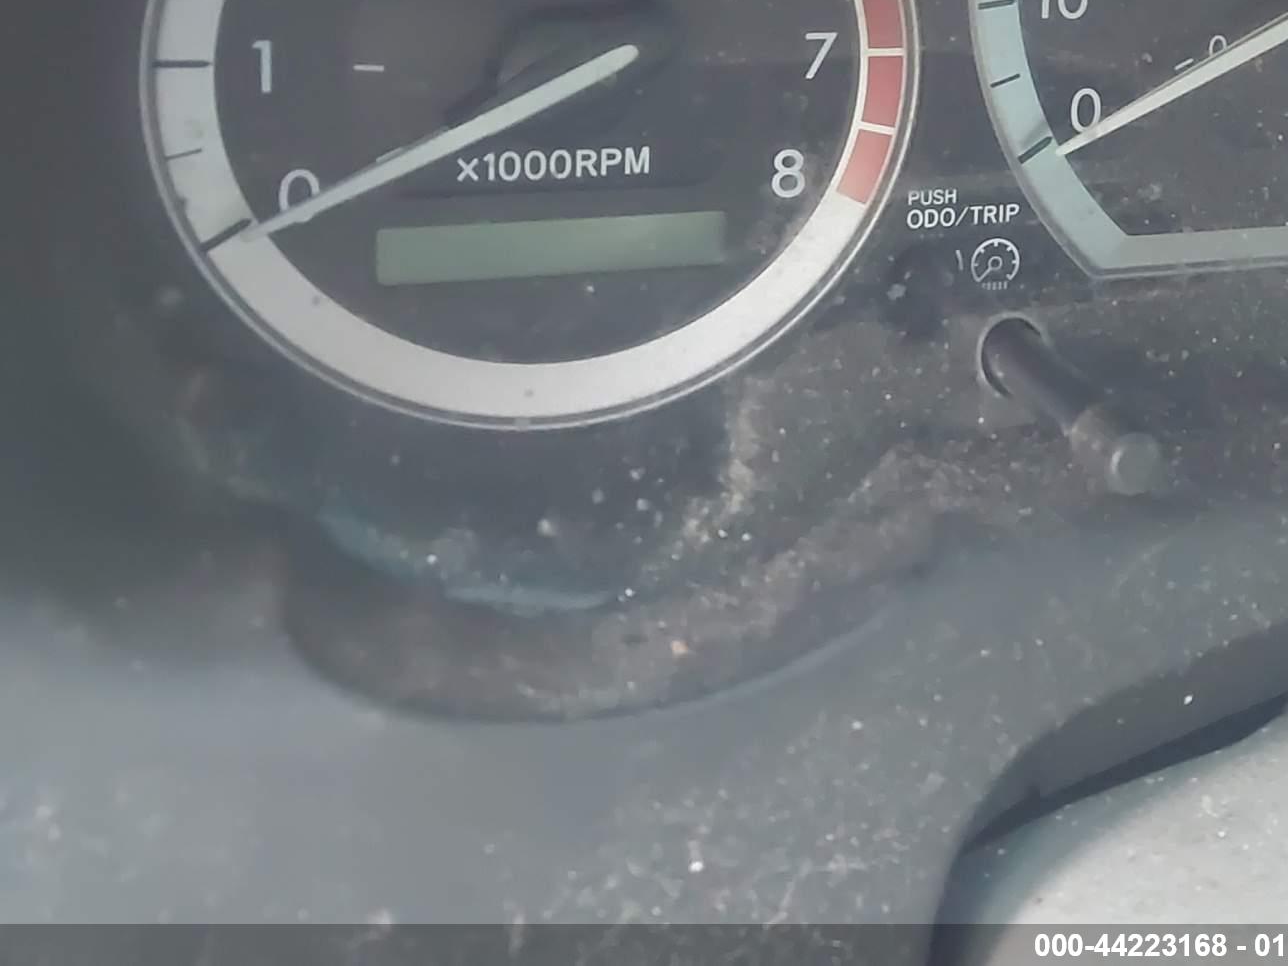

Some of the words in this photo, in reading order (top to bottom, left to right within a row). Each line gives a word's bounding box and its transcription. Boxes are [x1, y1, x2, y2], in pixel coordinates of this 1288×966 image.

[252, 41, 272, 93] 1
[805, 32, 838, 79] 7
[1070, 87, 1102, 134] 0
[279, 169, 320, 222] 0
[771, 149, 806, 198] 8
[907, 203, 1019, 229] ODO/TRIP
[908, 189, 957, 206] PUSH
